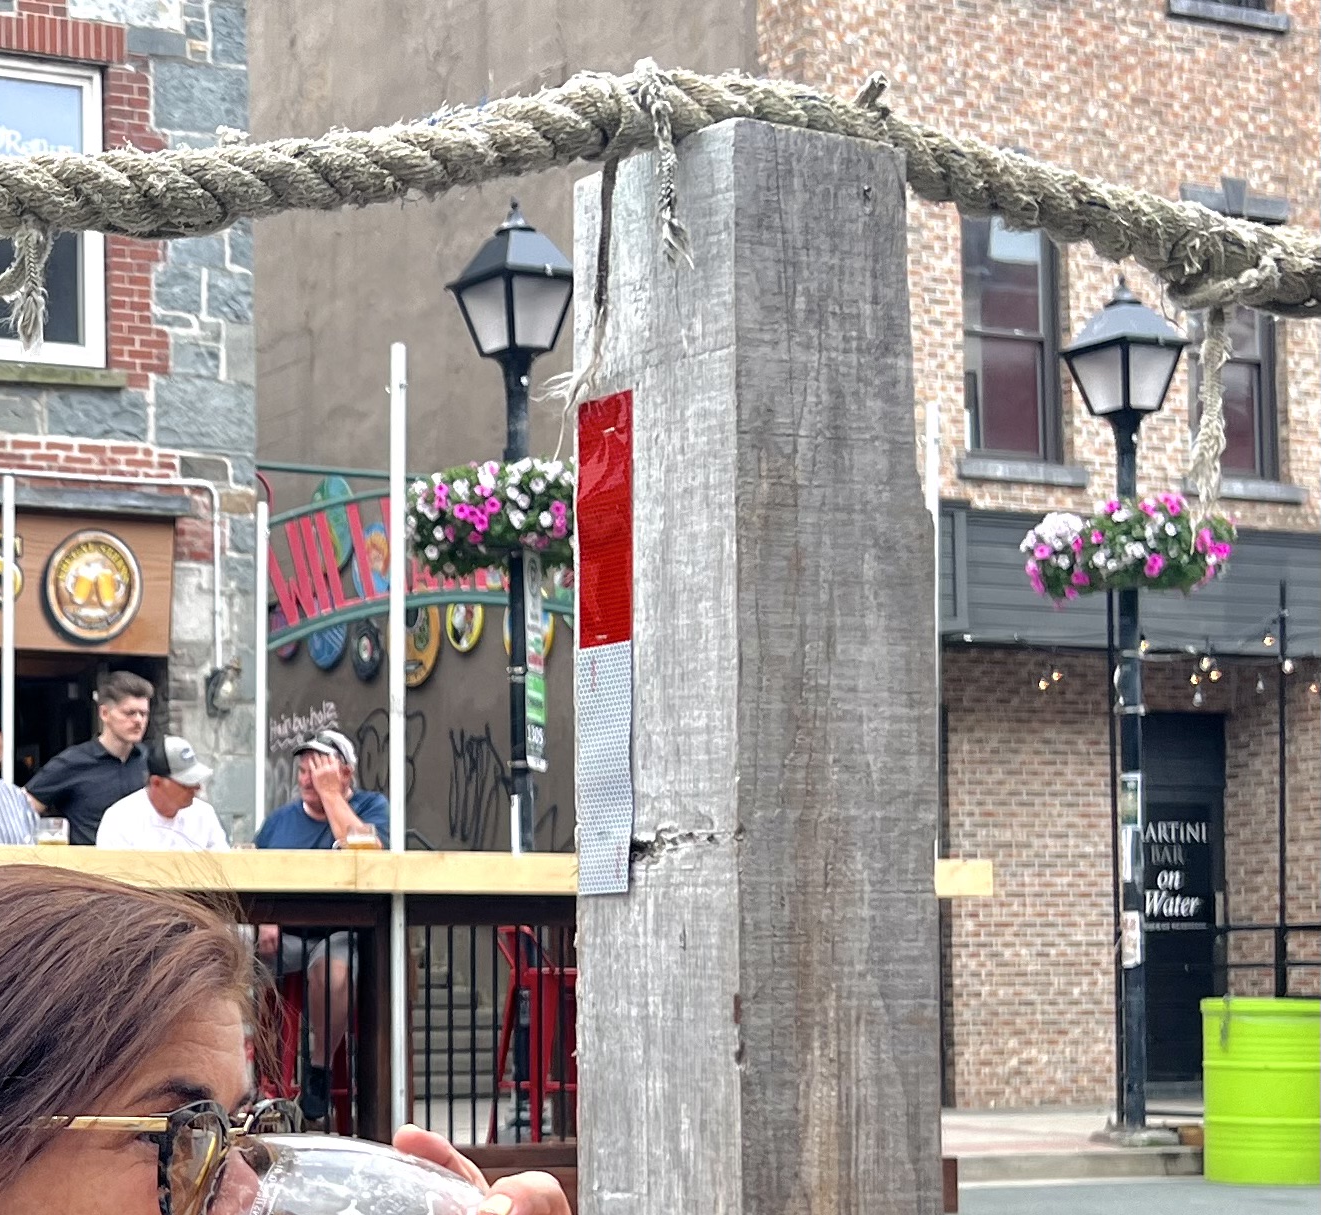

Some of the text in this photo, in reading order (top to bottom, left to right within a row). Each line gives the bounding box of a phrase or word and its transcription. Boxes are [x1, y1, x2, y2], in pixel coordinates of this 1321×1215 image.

[1151, 844, 1185, 866] BAR
[1157, 869, 1185, 891] on
[1145, 889, 1203, 918] Water
